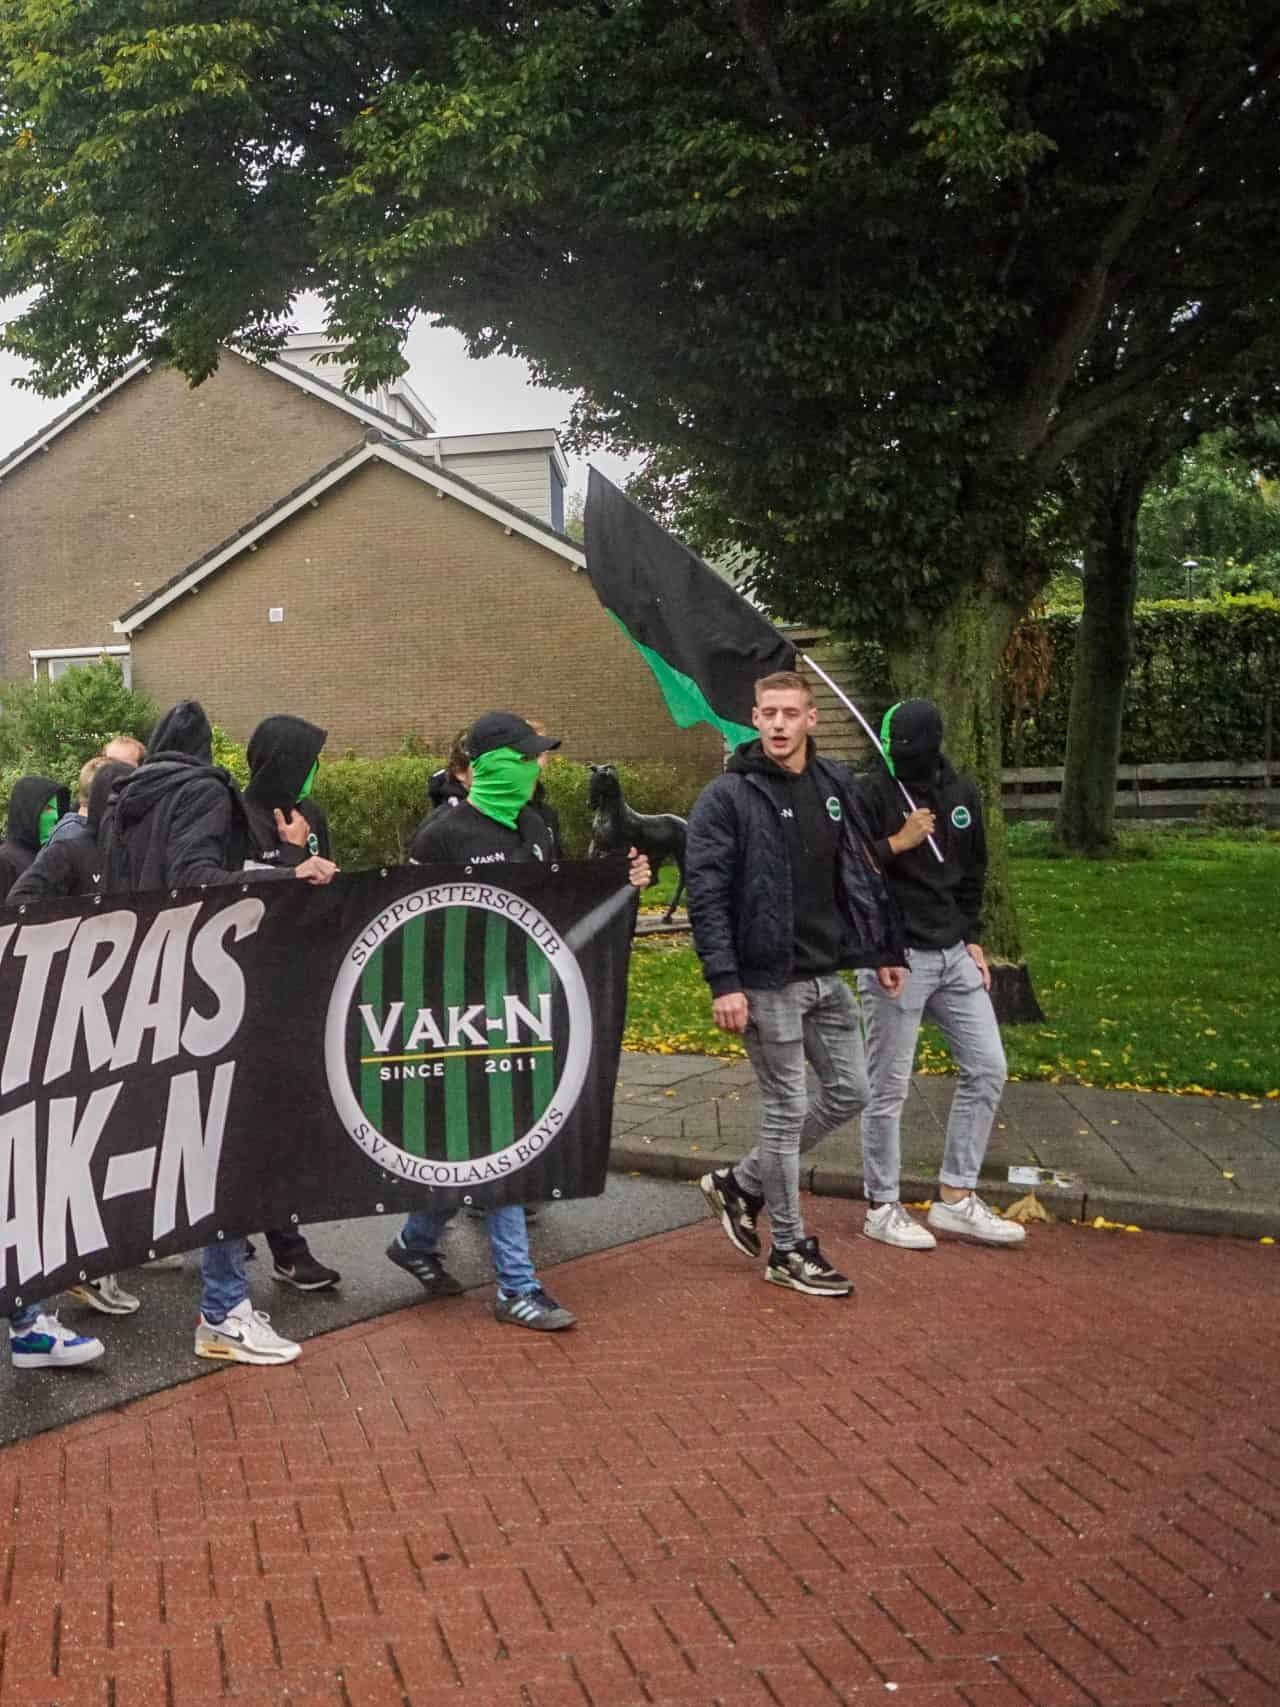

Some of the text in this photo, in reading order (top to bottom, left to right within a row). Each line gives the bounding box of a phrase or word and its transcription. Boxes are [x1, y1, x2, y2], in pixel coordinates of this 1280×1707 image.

[351, 886, 560, 966] SUPPORTERSCLUB
[358, 993, 553, 1052] VAK-N
[379, 1057, 536, 1081] SINCE 2011
[393, 1155, 513, 1184] NICOLAAS
[518, 1107, 564, 1162] BOYS
